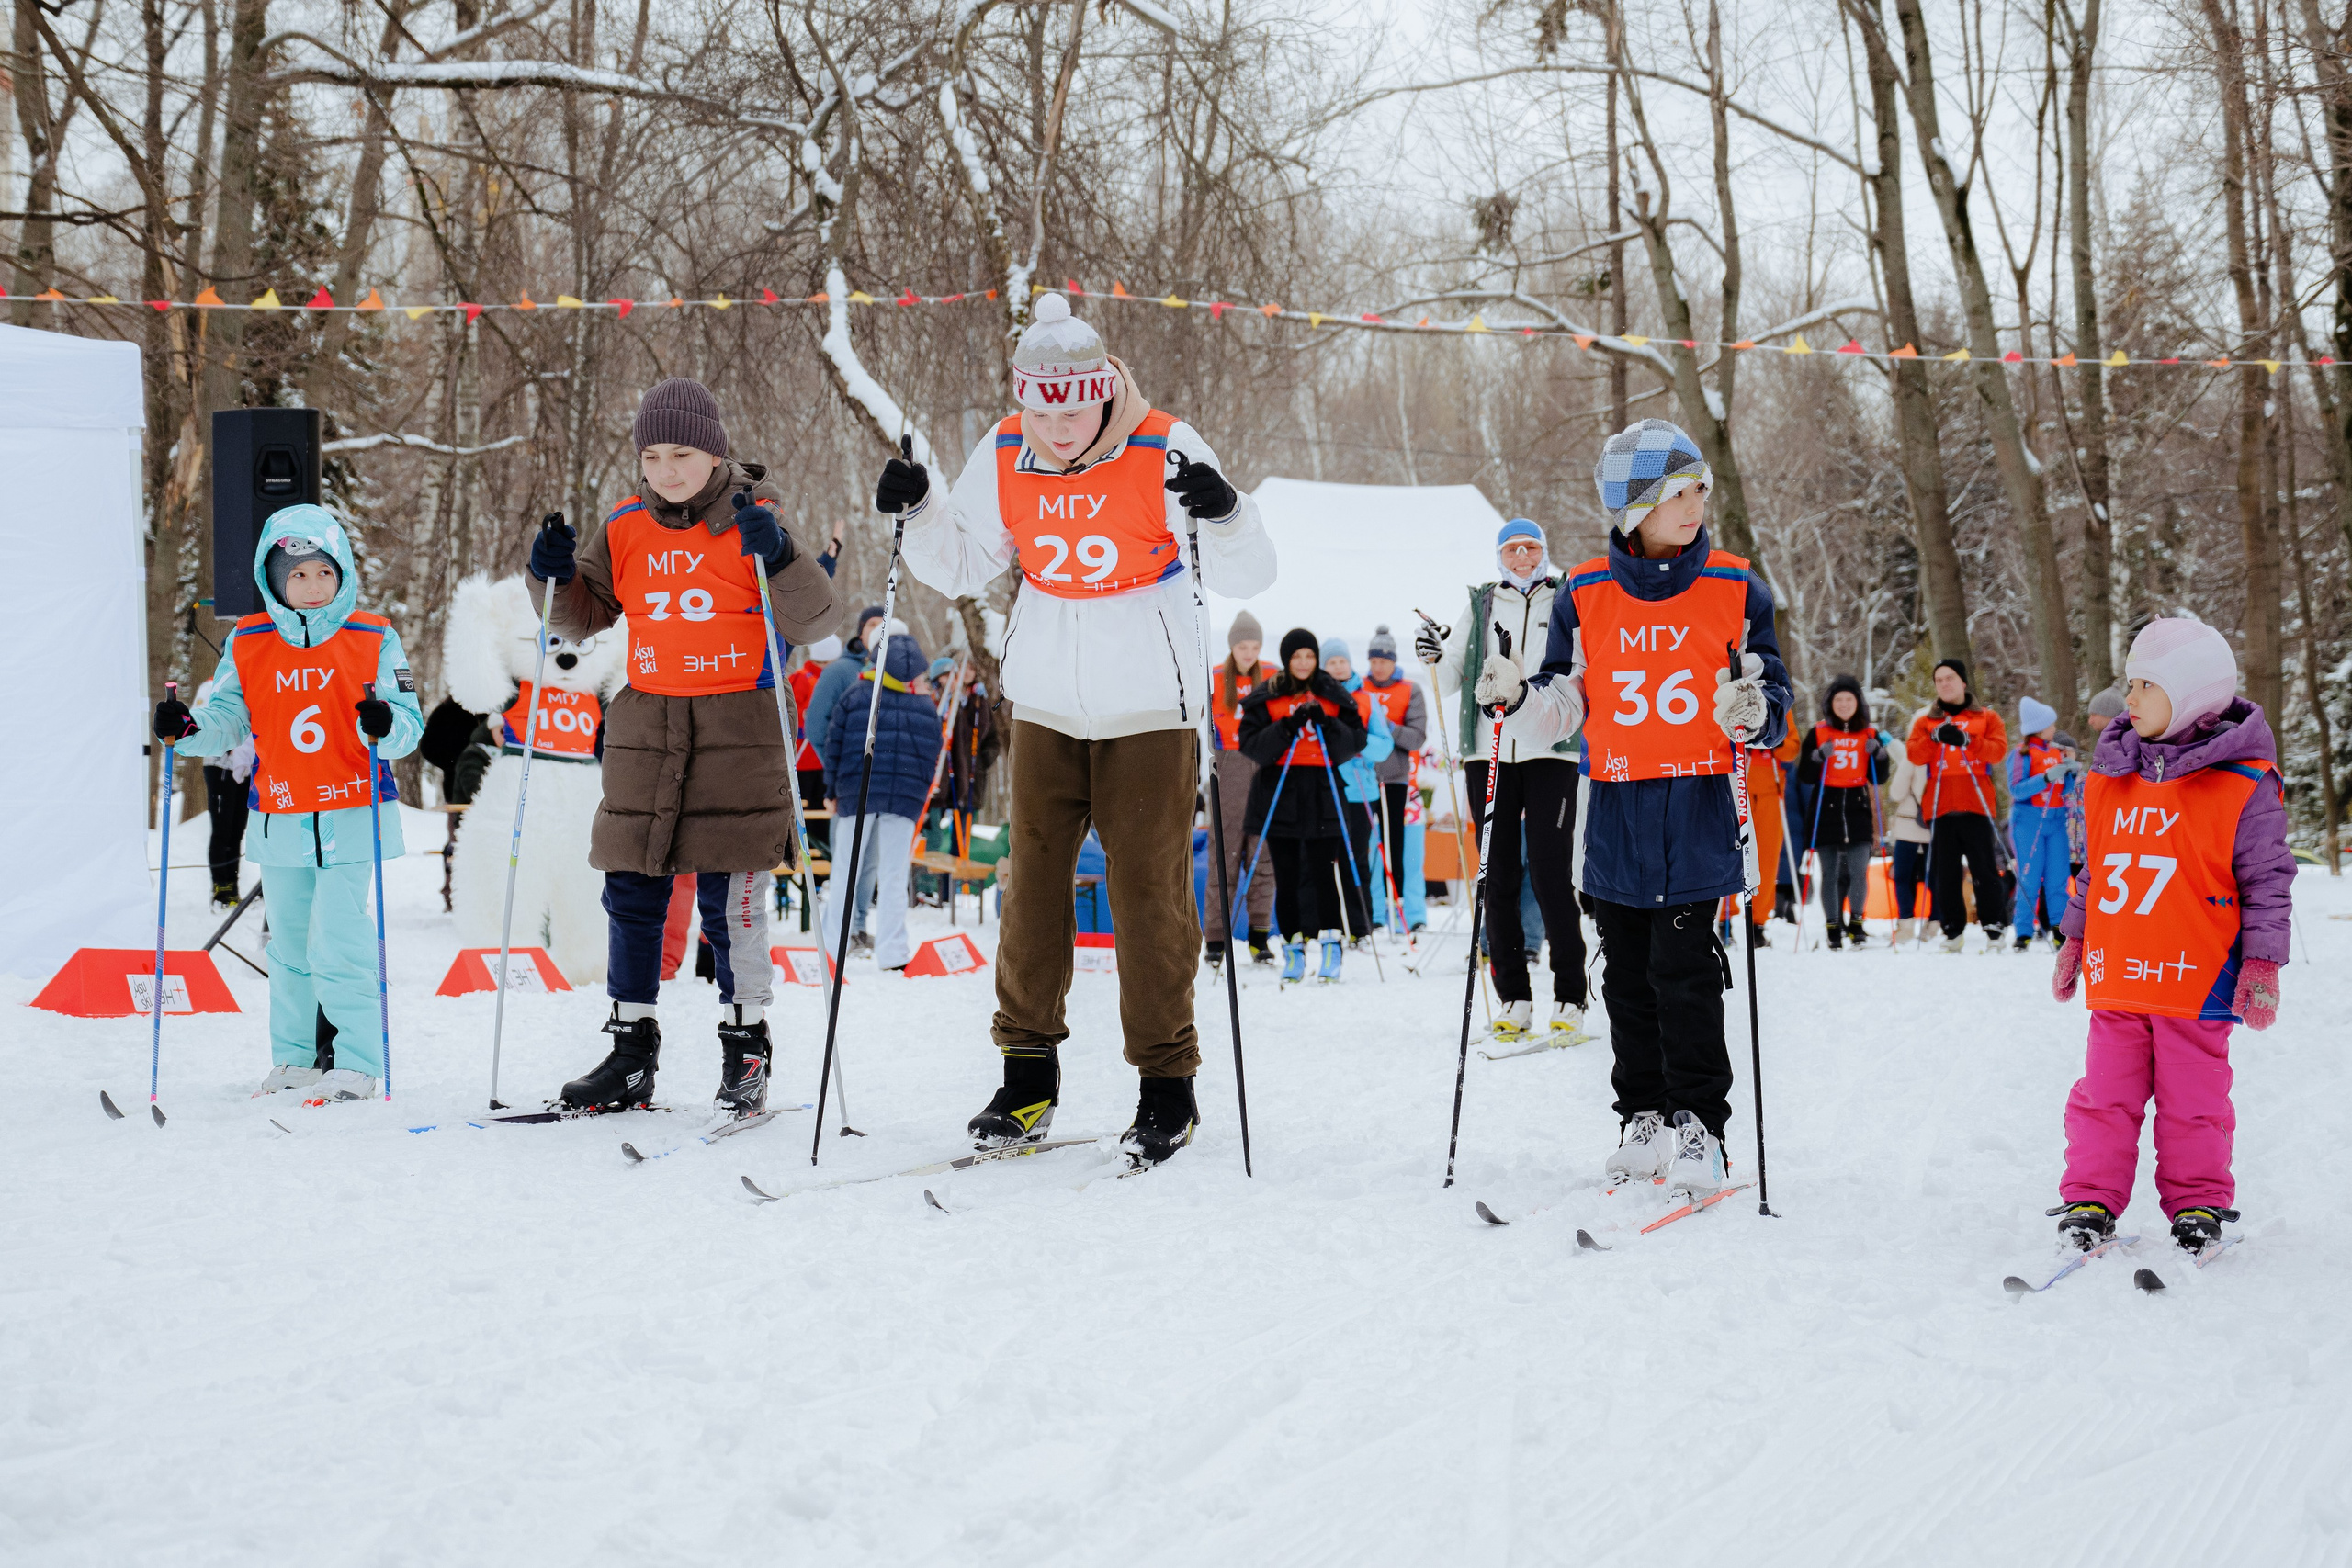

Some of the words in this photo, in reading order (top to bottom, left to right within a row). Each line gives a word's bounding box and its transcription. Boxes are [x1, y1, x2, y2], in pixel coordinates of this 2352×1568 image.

[1038, 494, 1108, 520] МГУ
[647, 550, 705, 577] МГУ
[1034, 535, 1119, 583] 29
[1619, 625, 1690, 654] МГУ
[276, 668, 335, 694] МГУ
[548, 692, 580, 705] МГУ
[1611, 668, 1700, 727] 36
[290, 704, 326, 754] 6
[537, 707, 595, 737] 100
[1834, 737, 1859, 748] МГУ
[1486, 734, 1499, 797] NORDWAY
[1833, 750, 1859, 770] 31
[1736, 751, 1747, 817] NORDWAY
[1484, 826, 1491, 837] JR
[2112, 806, 2180, 837] МГУ
[2098, 852, 2177, 916] 37
[972, 1148, 1019, 1166] FISCHER
